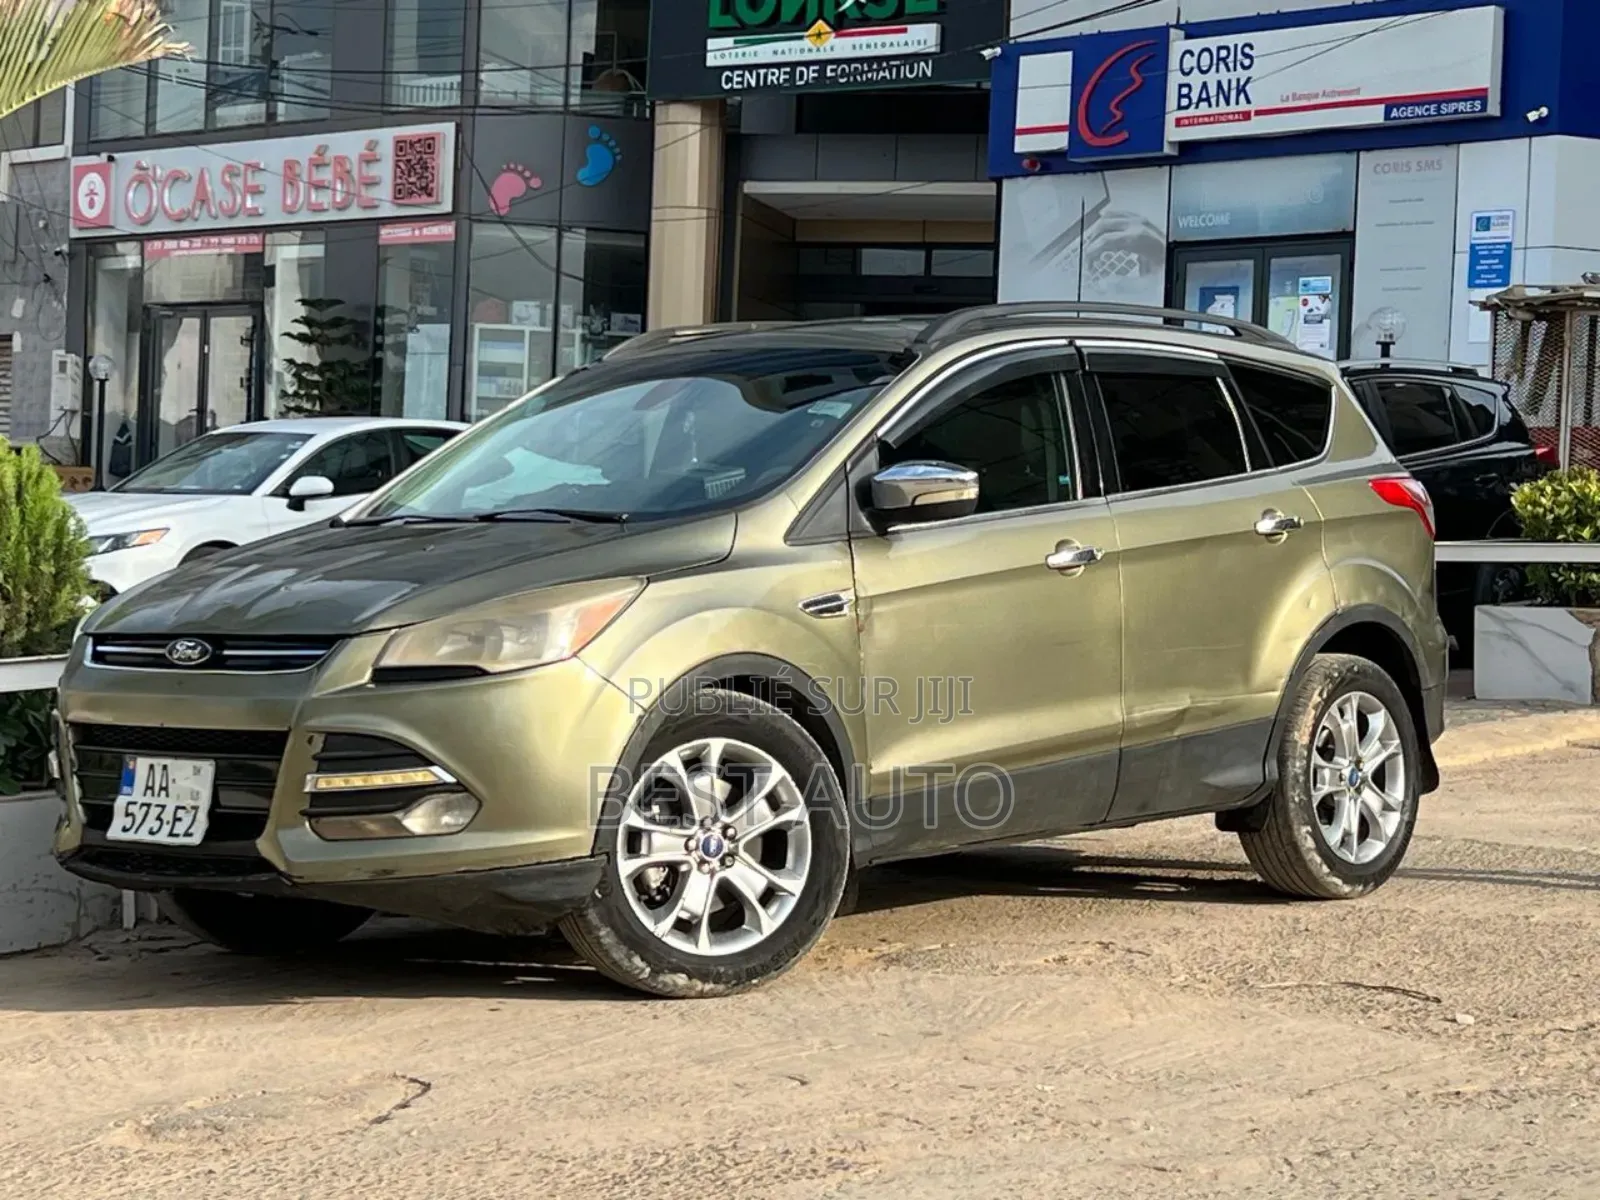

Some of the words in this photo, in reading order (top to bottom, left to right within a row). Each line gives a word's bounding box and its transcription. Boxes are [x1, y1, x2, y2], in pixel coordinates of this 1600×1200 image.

[713, 50, 759, 61] LOTERIE
[772, 45, 835, 57] NATIONALE
[1178, 43, 1255, 77] CORIS
[721, 67, 790, 89] CENTRE
[795, 65, 820, 86] DE
[1176, 77, 1253, 111] BANK
[1291, 91, 1319, 103] Banque
[1390, 104, 1438, 118] AGENCE
[1440, 100, 1482, 114] SIPRES
[1180, 113, 1245, 126] INTERNATIONAL
[1415, 160, 1443, 173] SMS
[281, 139, 382, 215] BÉBÉ
[1178, 212, 1231, 229] WELCOME
